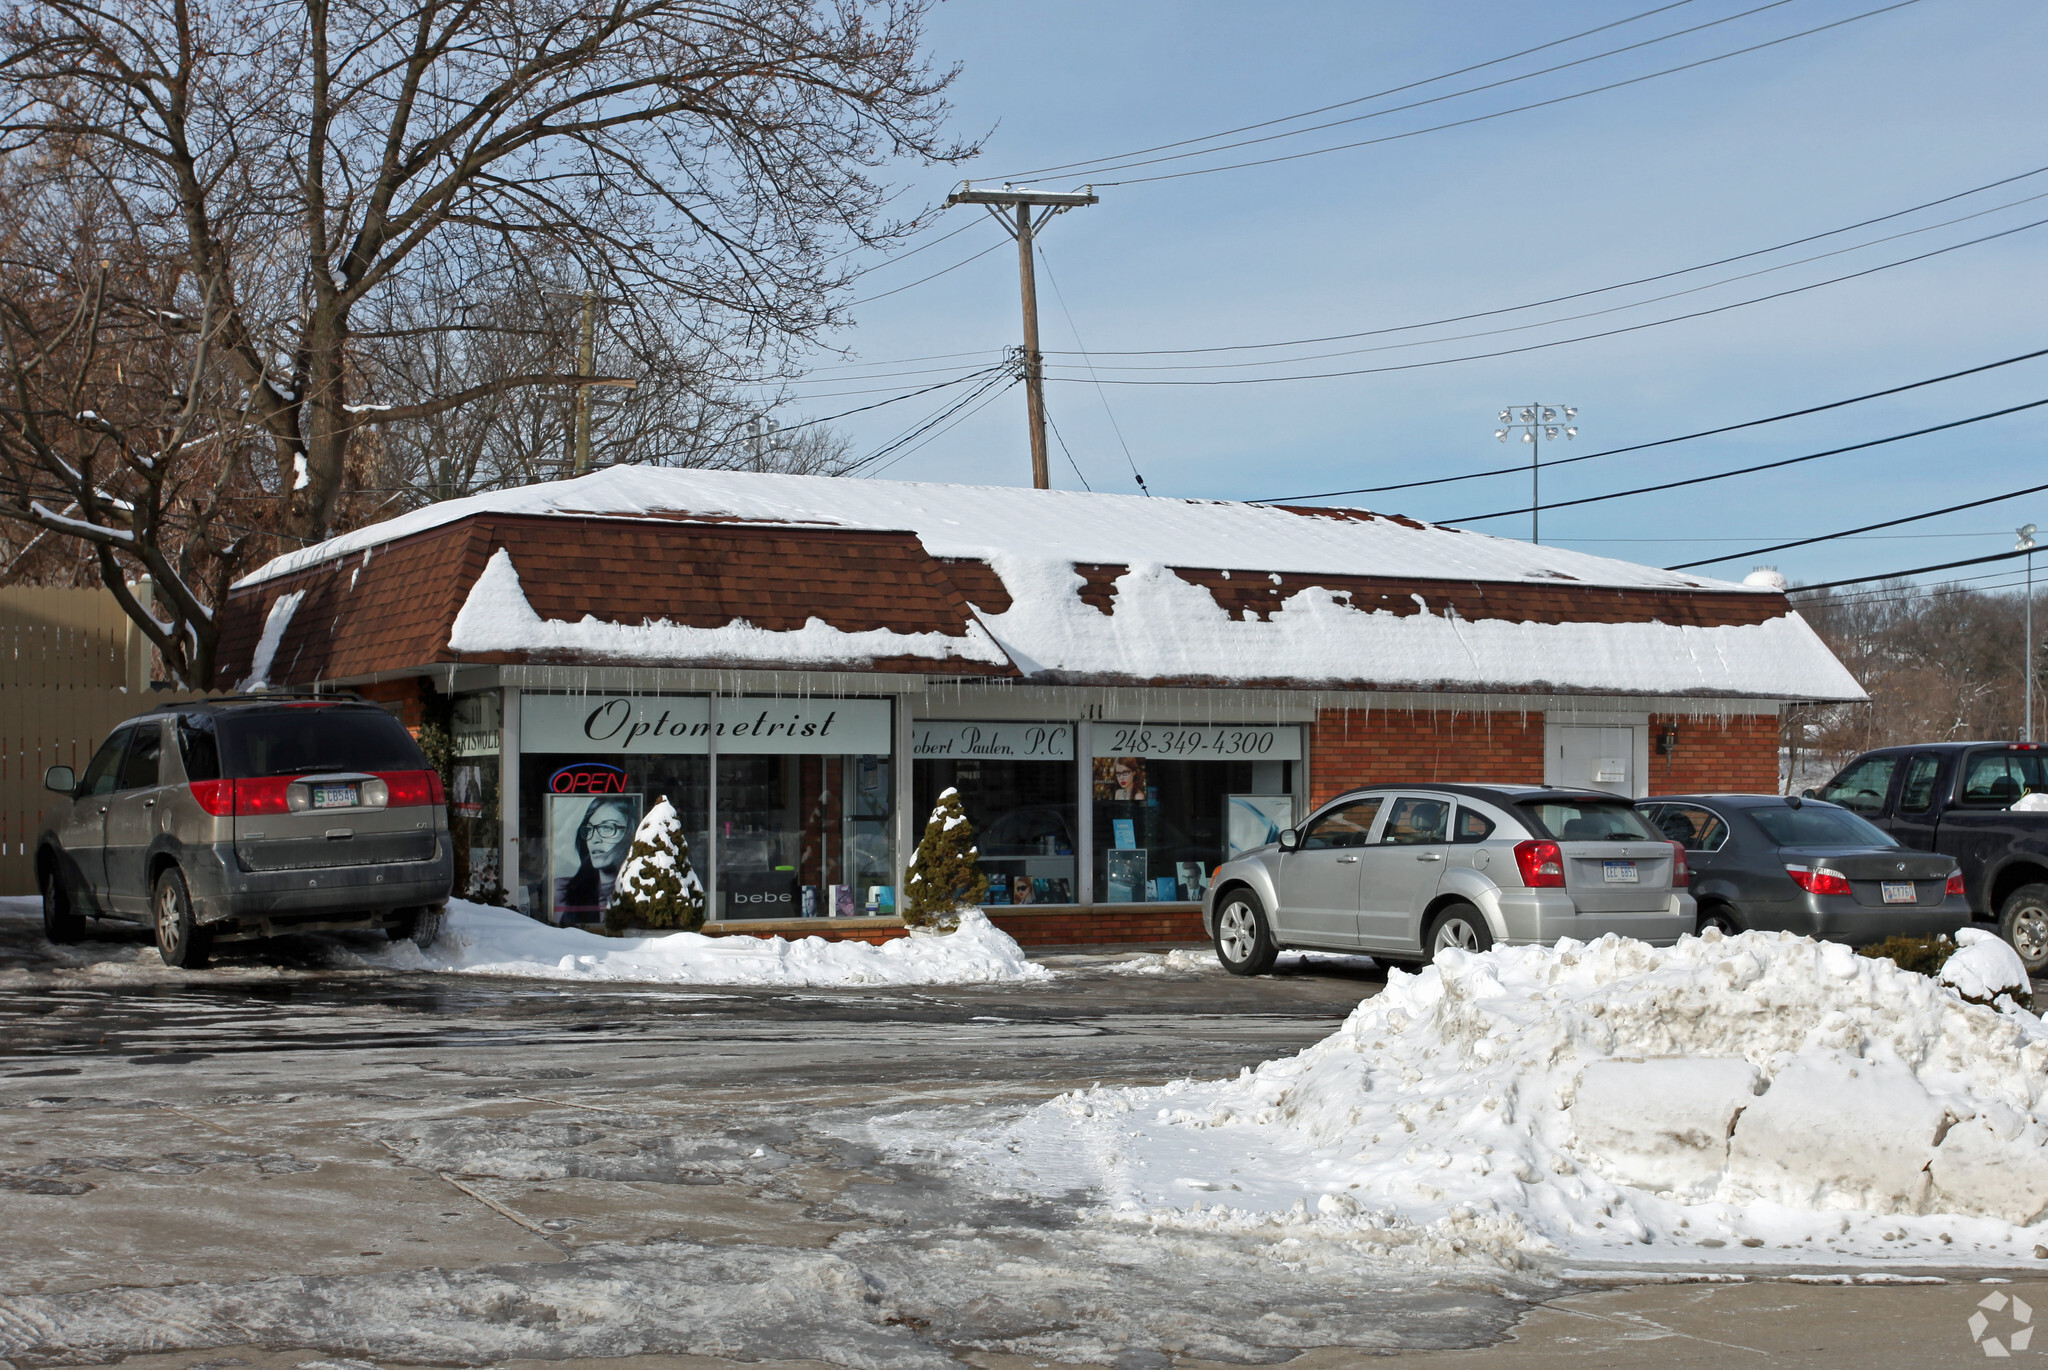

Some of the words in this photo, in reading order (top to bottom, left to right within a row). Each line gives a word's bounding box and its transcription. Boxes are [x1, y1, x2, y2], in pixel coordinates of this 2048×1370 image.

[583, 698, 836, 749] Optometrist
[455, 730, 500, 751] GRISWOLD
[912, 731, 954, 754] obert
[960, 726, 1014, 756] Paulen,
[1023, 727, 1067, 756] P.C.
[1110, 729, 1274, 755] 248-349-4300
[552, 772, 629, 793] OPEN
[735, 892, 792, 904] bebe
